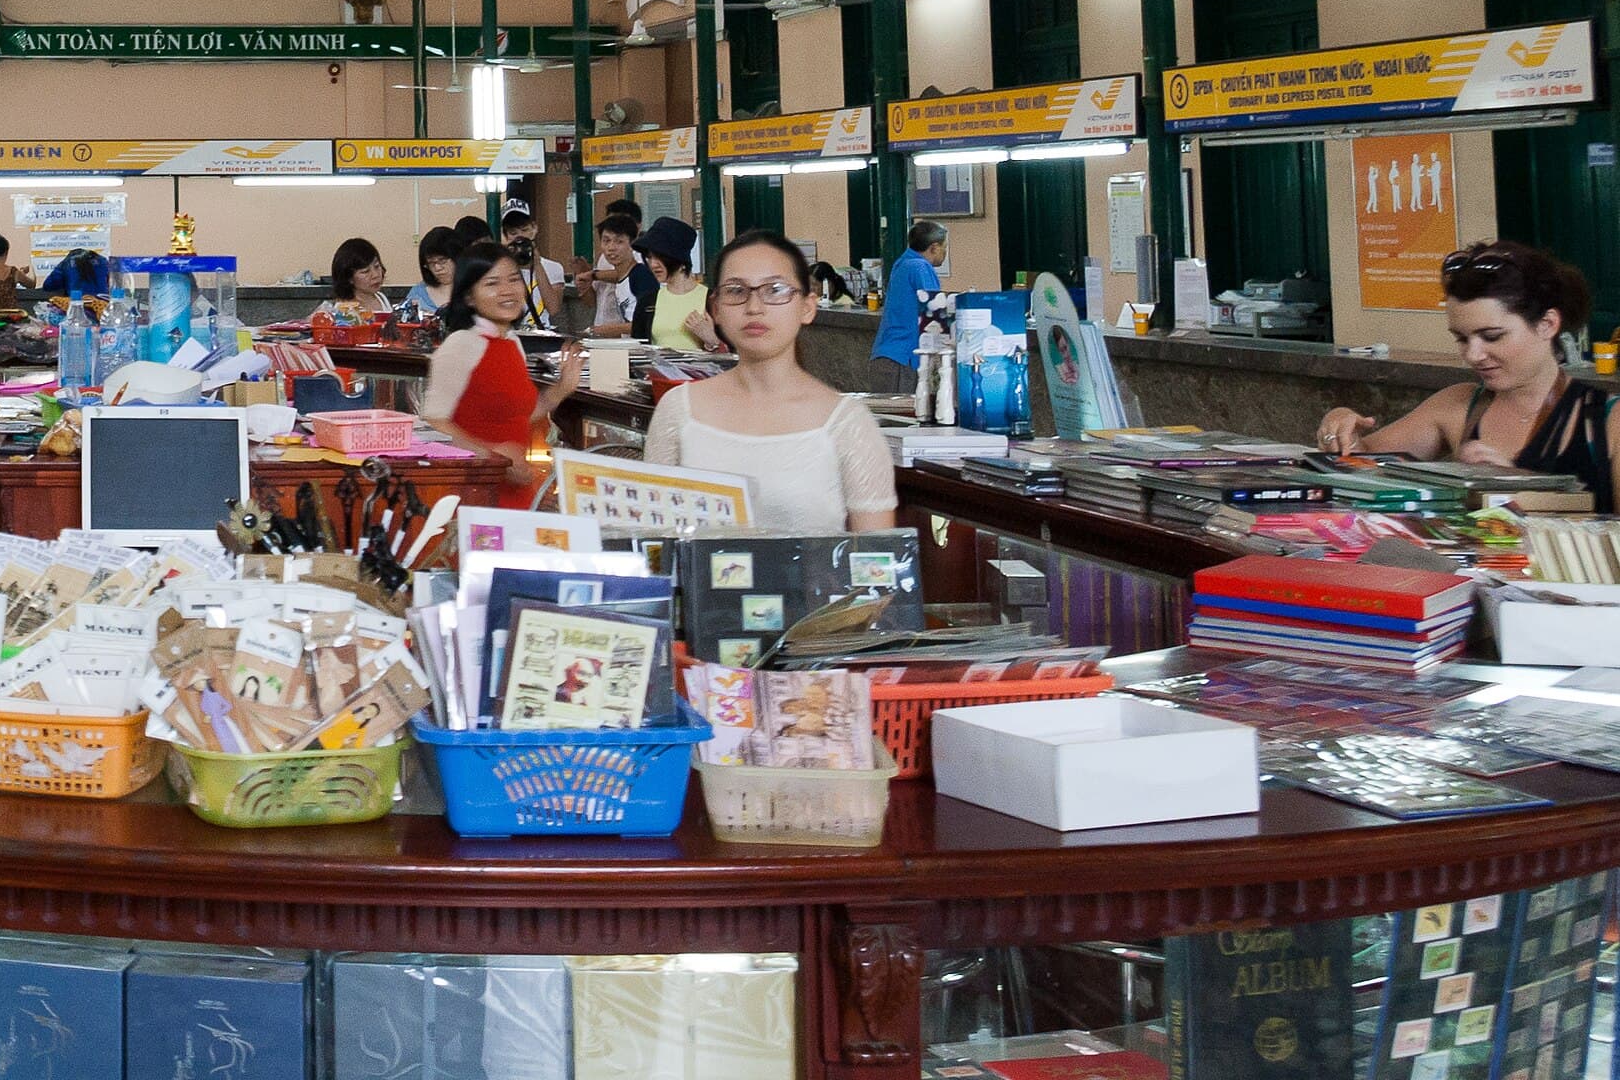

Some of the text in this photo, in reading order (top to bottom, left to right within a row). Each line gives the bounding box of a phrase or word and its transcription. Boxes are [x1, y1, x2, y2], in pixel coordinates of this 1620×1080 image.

[24, 29, 346, 55] AN TOÀN TIỆN LỢI VĂN MINH
[1221, 67, 1252, 93] CHUYỂN
[1254, 69, 1275, 89] PHÁT
[1278, 69, 1306, 87] NHANH
[1309, 66, 1338, 84] TRONG
[1340, 59, 1364, 80] NƯỚC
[1404, 52, 1431, 74] NƯỚC
[1548, 69, 1577, 79] POST
[1229, 85, 1373, 108] ORDINARY AND EXPRESS POSTAL ITEMS
[12, 144, 62, 160] KIỆN
[366, 146, 463, 160] VN QUICKPOST
[85, 624, 144, 636] MAGNET
[1231, 957, 1330, 998] ALBUM
